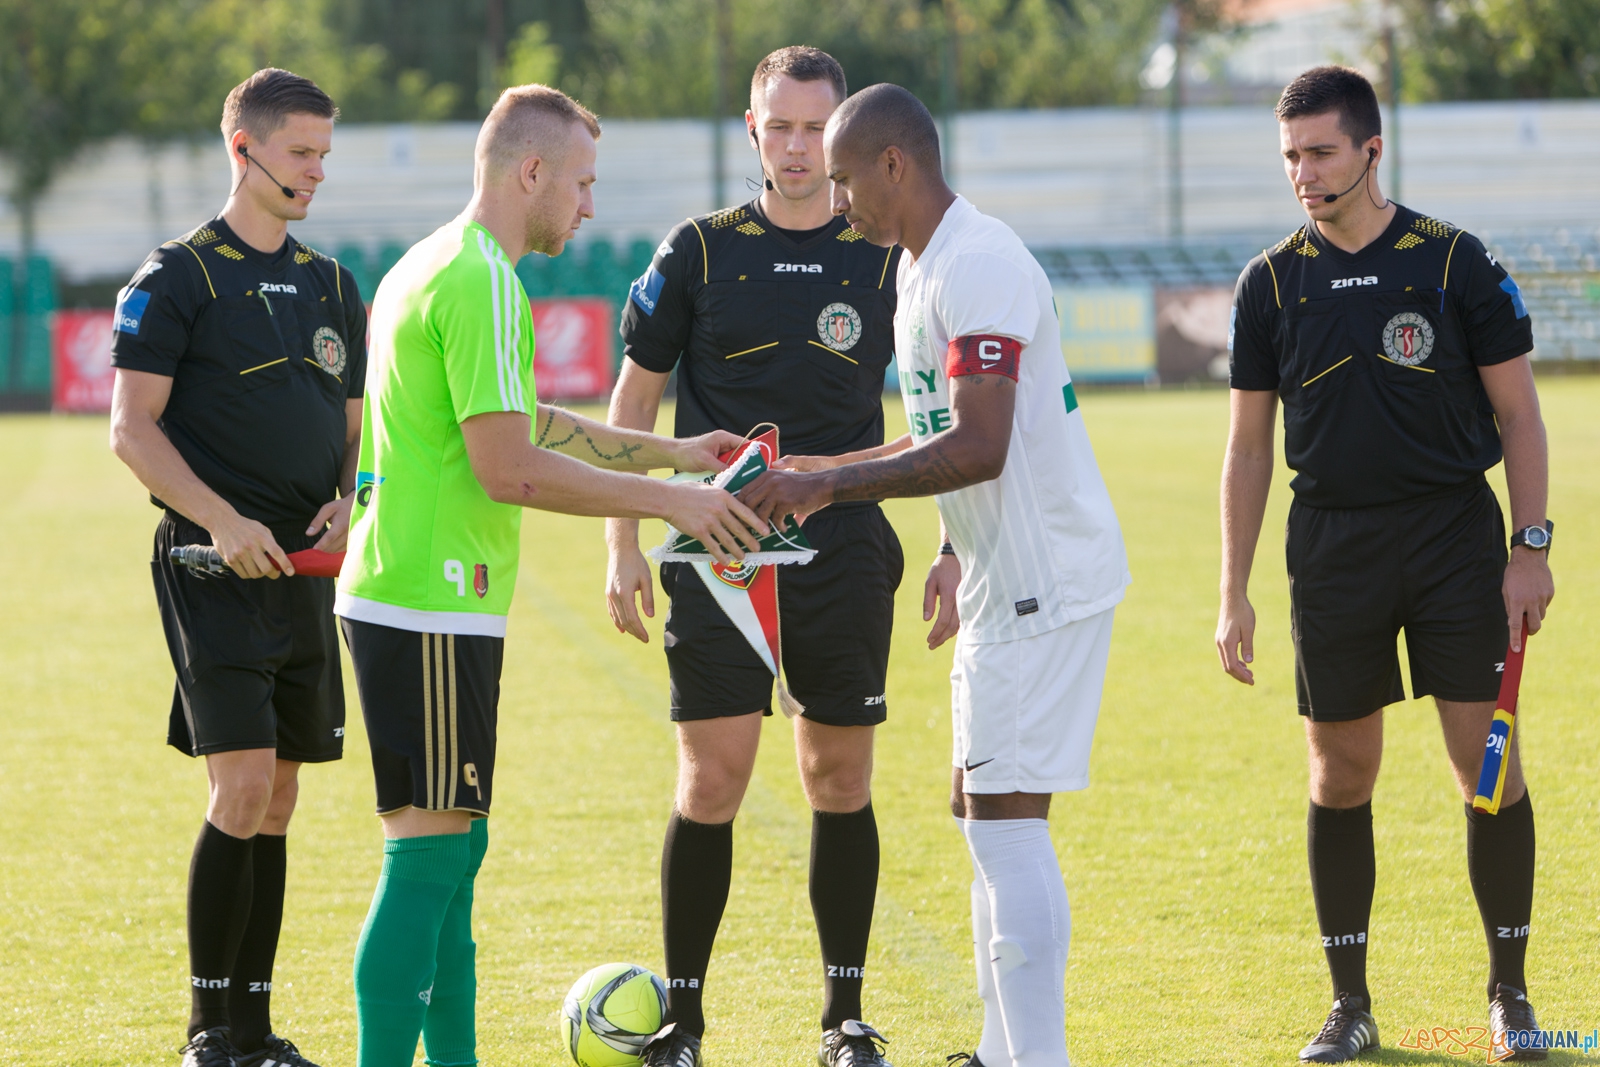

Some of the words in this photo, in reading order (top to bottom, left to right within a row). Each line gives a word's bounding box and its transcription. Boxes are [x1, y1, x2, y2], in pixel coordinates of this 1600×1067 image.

[978, 340, 1003, 361] C
[444, 559, 466, 597] 9
[463, 762, 482, 802] 9
